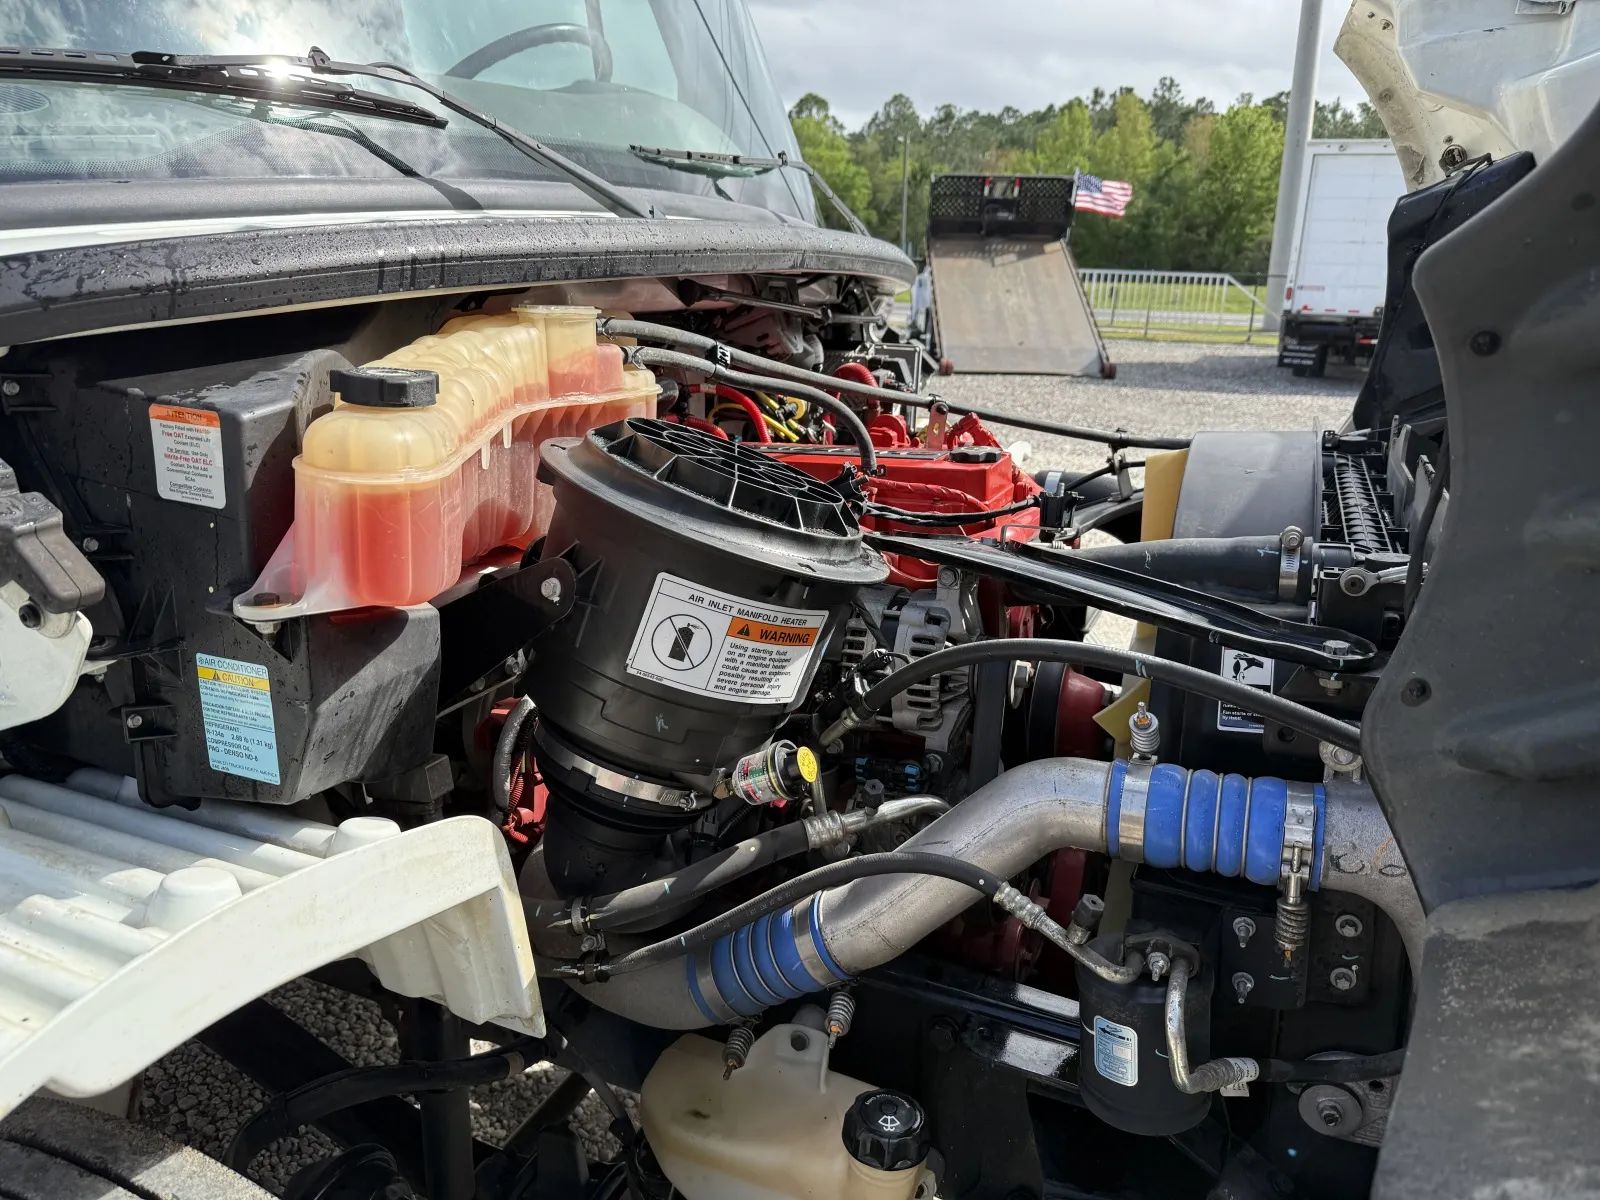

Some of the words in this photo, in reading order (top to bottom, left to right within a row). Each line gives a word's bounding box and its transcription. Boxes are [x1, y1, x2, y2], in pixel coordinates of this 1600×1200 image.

[162, 430, 173, 438] Free
[173, 431, 184, 439] OAT
[191, 456, 202, 464] OAT
[203, 458, 213, 466] ELC
[688, 593, 705, 604] AIR
[708, 600, 734, 613] INLET
[737, 608, 778, 623] MANIFOLD
[781, 616, 807, 626] HEATER
[760, 629, 810, 644] WARNING
[730, 642, 749, 652] Using
[751, 647, 774, 656] starting
[748, 654, 767, 662] engine
[204, 657, 217, 667] AIR
[217, 659, 268, 678] CONDITIONER
[721, 663, 739, 671] could
[746, 661, 770, 669] manifold
[222, 673, 255, 687] CAUTION
[718, 670, 746, 680] possibly
[748, 675, 773, 684] resulting
[716, 677, 738, 686] severe
[740, 681, 766, 690] personal
[767, 683, 781, 691] injury
[728, 686, 749, 695] engine
[205, 721, 241, 733] REFRIGERANT:
[206, 728, 225, 738] R-134a
[250, 739, 263, 747] (1.31
[264, 741, 274, 750] kg)
[207, 737, 242, 749] COMPRESSOR
[208, 745, 220, 753] PAG
[224, 748, 244, 758] DENSO
